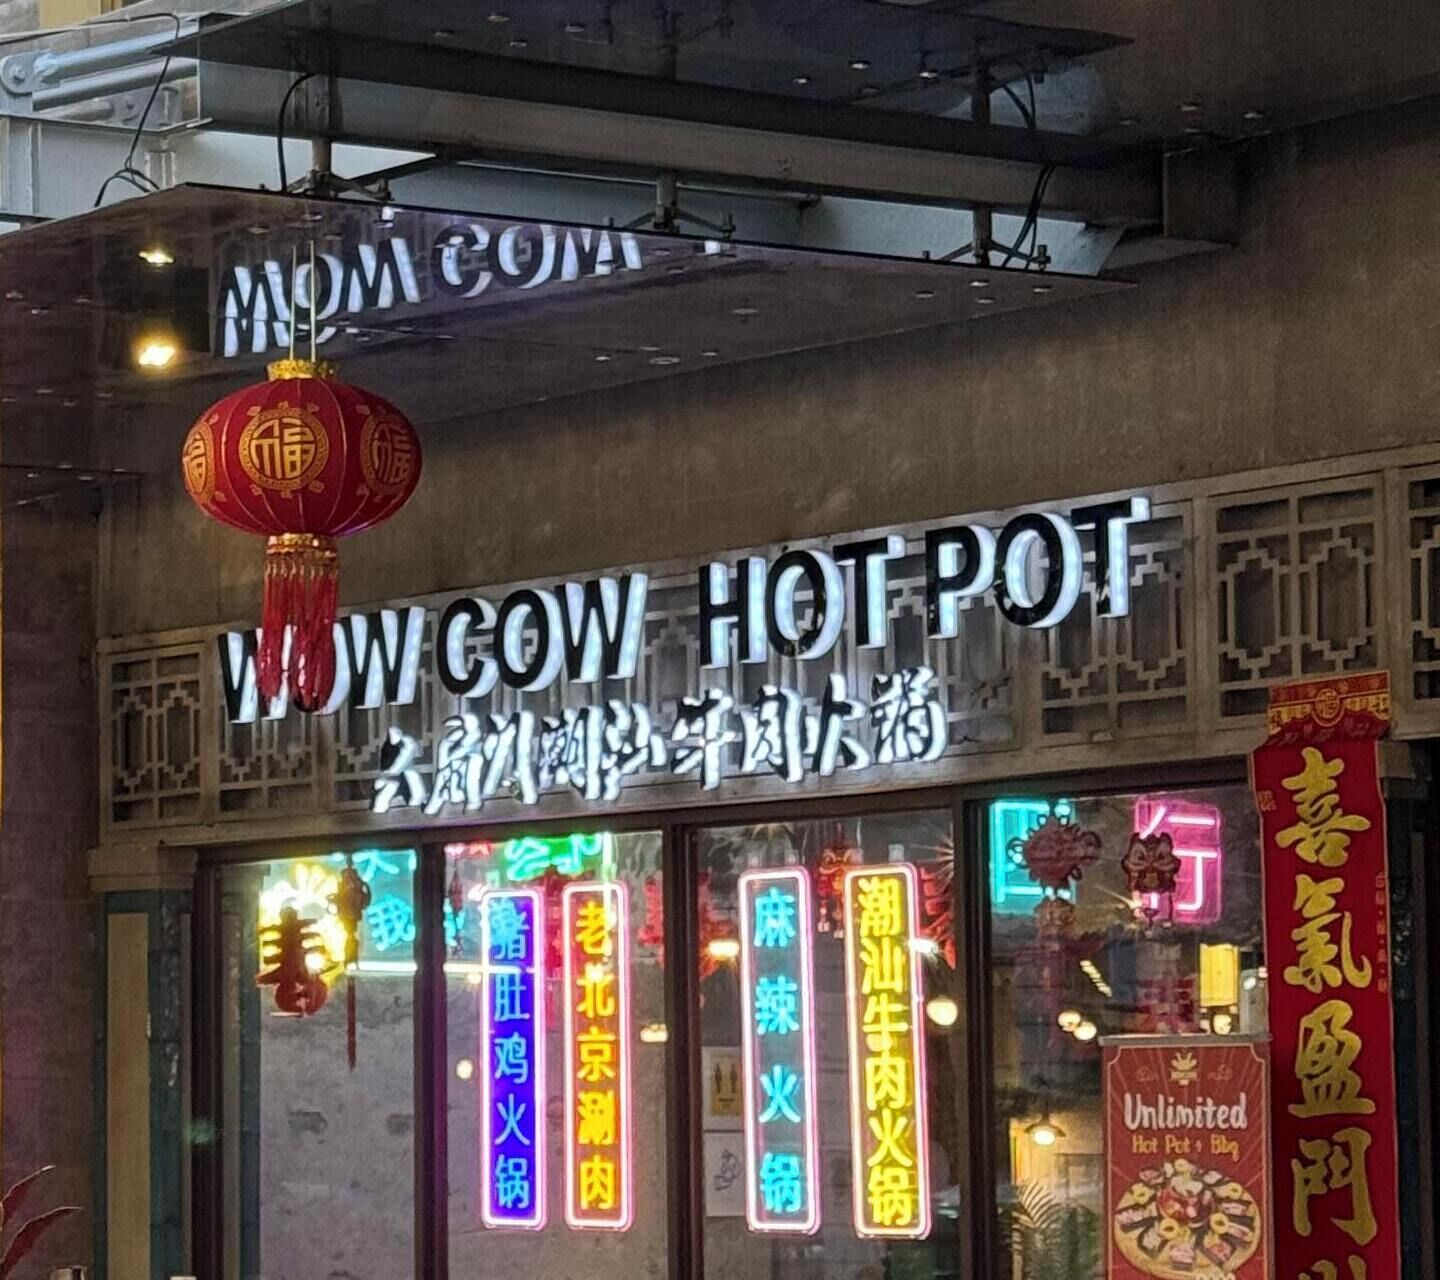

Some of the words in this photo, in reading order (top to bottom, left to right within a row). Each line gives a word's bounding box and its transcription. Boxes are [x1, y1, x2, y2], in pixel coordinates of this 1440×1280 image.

[437, 573, 648, 699] COW
[699, 534, 906, 669] HOT
[926, 495, 1152, 640] POT
[754, 886, 802, 1214] 麻辣火锅
[857, 875, 915, 1226] 潮汕牛肉火锅
[1124, 1092, 1248, 1130] Unlimited
[1132, 1134, 1158, 1154] Hot
[1165, 1134, 1191, 1154] Pot
